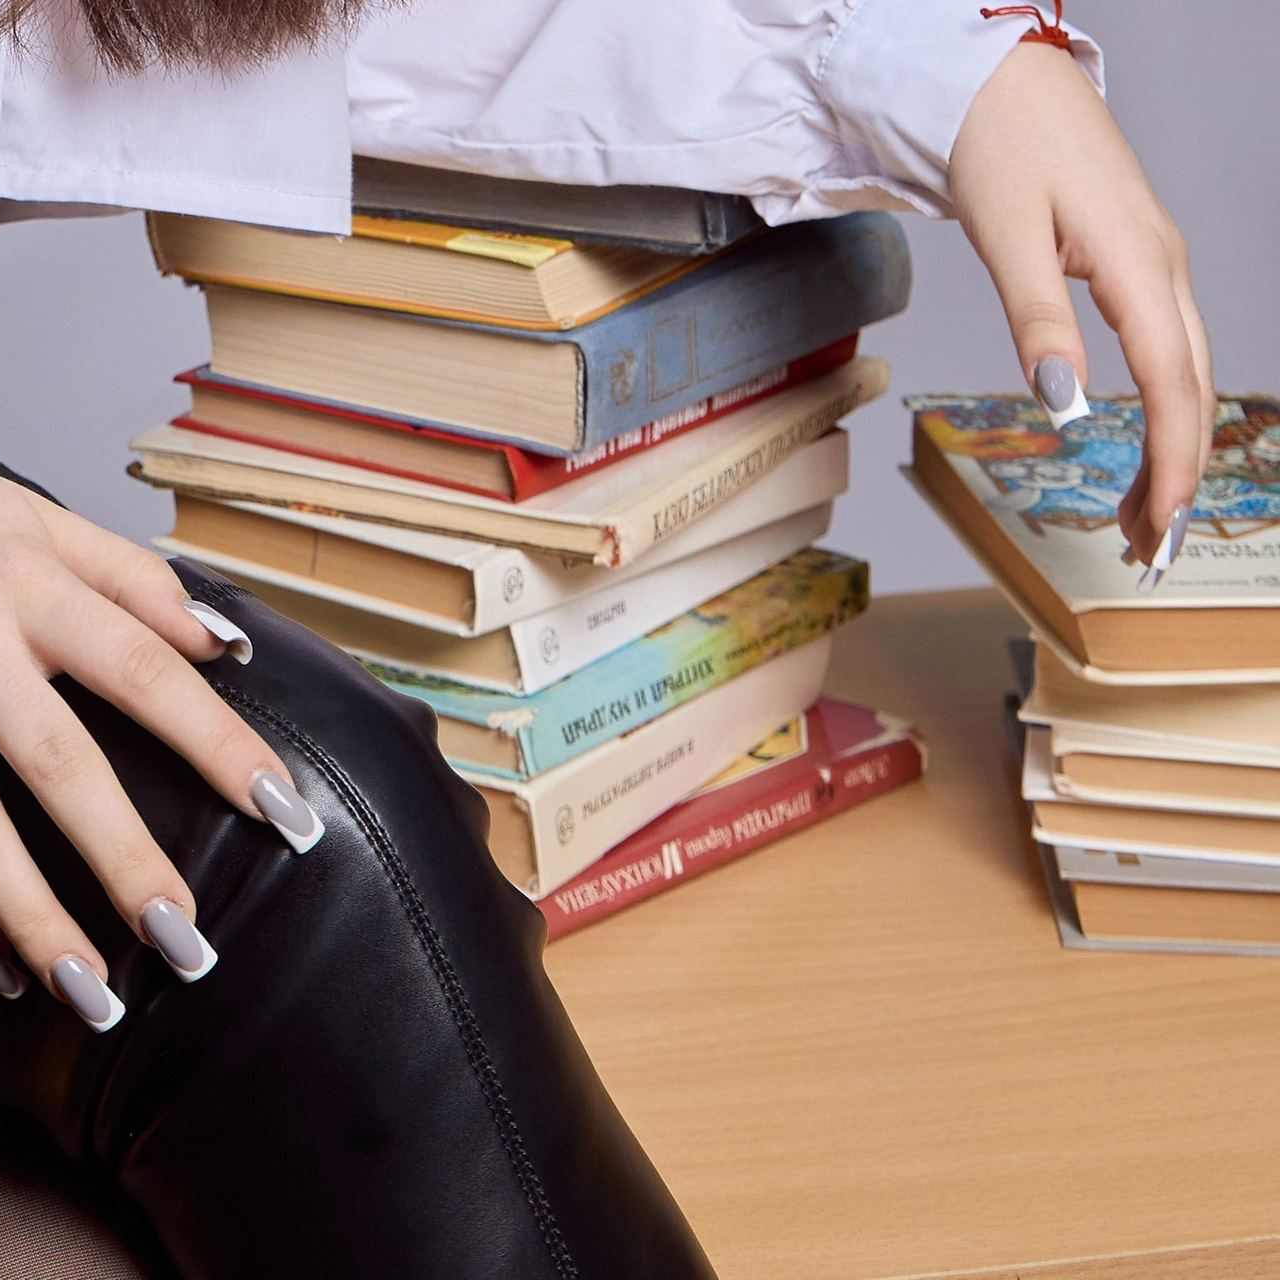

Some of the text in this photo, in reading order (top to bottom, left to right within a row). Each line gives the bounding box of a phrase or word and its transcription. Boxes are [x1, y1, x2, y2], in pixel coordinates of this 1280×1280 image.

[561, 657, 715, 745] ХИТРЫЙ И МУДРЫЙ
[733, 791, 811, 840] ПРЫГОДЫ
[685, 824, 732, 859] барона
